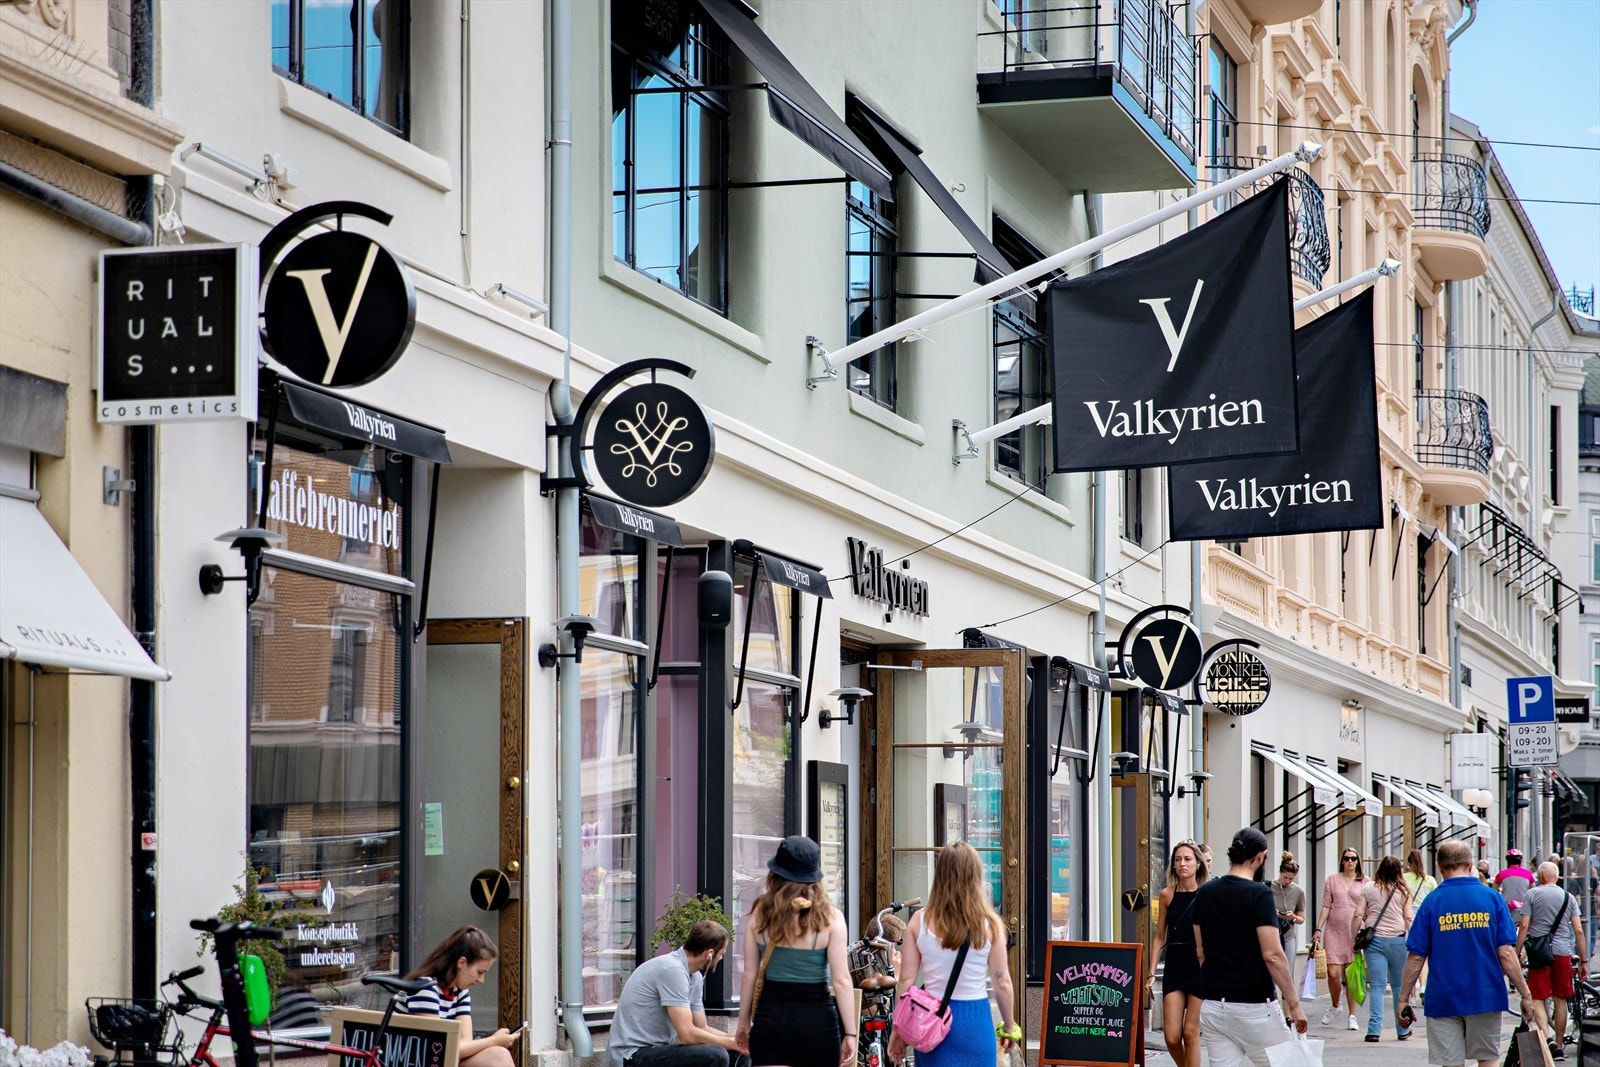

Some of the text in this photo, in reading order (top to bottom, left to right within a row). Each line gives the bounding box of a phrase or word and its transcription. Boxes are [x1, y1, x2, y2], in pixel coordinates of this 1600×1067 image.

[102, 401, 238, 418] cosmetics
[1083, 393, 1266, 444] Valkyrien
[342, 401, 397, 441] Valkyrien
[1195, 473, 1354, 517] Valkyrien
[615, 503, 655, 534] Valkyrien
[781, 560, 811, 587] Valkyrien
[847, 536, 930, 623] Valkyrien
[1215, 651, 1260, 664] ONIK
[1215, 704, 1260, 716] ONIK
[1518, 683, 1542, 718] P
[1533, 755, 1550, 763] avgift
[1438, 912, 1490, 925] GÖTEBORG
[1440, 921, 1490, 931] MUSIC FESTIVAL
[298, 923, 359, 945] Konseptbutikk
[301, 947, 355, 969] underetasjen
[1055, 962, 1133, 988] VELKOMMEN
[1085, 975, 1098, 984] TIL
[1072, 1006, 1104, 1016] SUPPER OG
[1054, 1025, 1070, 1034] FOOD
[1070, 1026, 1089, 1035] COURT
[1106, 1018, 1125, 1028] JUICE
[343, 1028, 428, 1067] VELOMMEN
